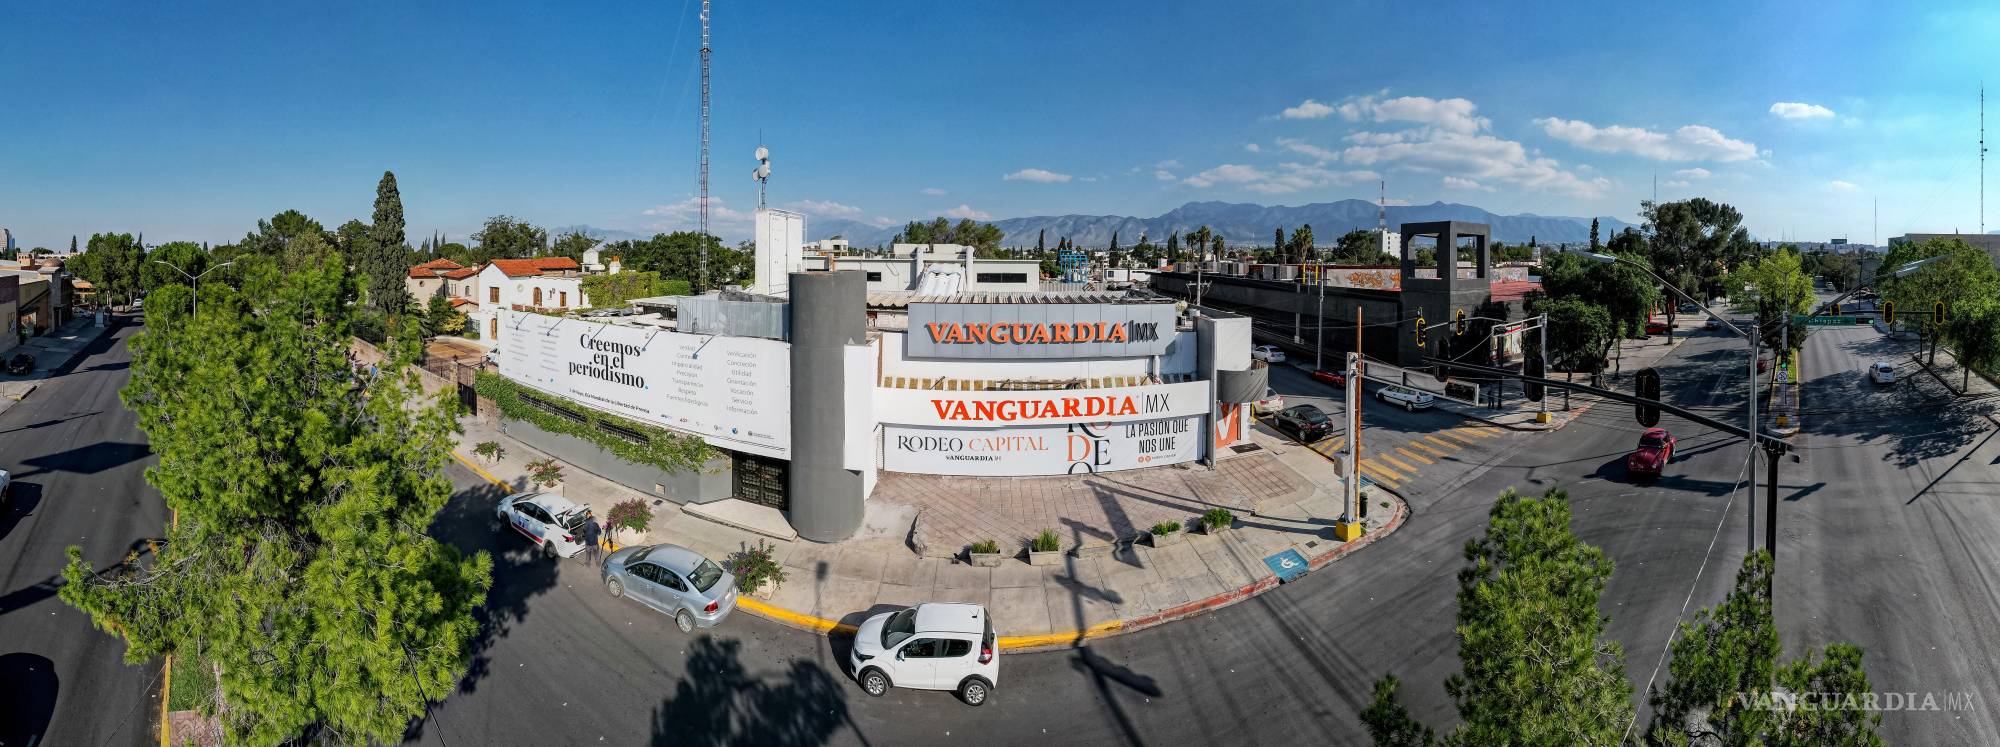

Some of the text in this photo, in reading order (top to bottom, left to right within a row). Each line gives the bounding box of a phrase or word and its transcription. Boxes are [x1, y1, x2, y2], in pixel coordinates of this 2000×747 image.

[925, 321, 1159, 345] VANGUARDIA MX
[580, 333, 641, 357] Creemos
[593, 352, 609, 366] en
[612, 350, 625, 369] el
[569, 361, 649, 390] periodismo.
[931, 393, 1170, 422] VANGUARDIA MX
[1125, 423, 1136, 439] LA
[1138, 419, 1170, 438] PASIÓN
[1172, 418, 1189, 435] QUE
[898, 435, 1049, 452] RODEO CAPITAL
[1138, 436, 1176, 454] NOS UNE
